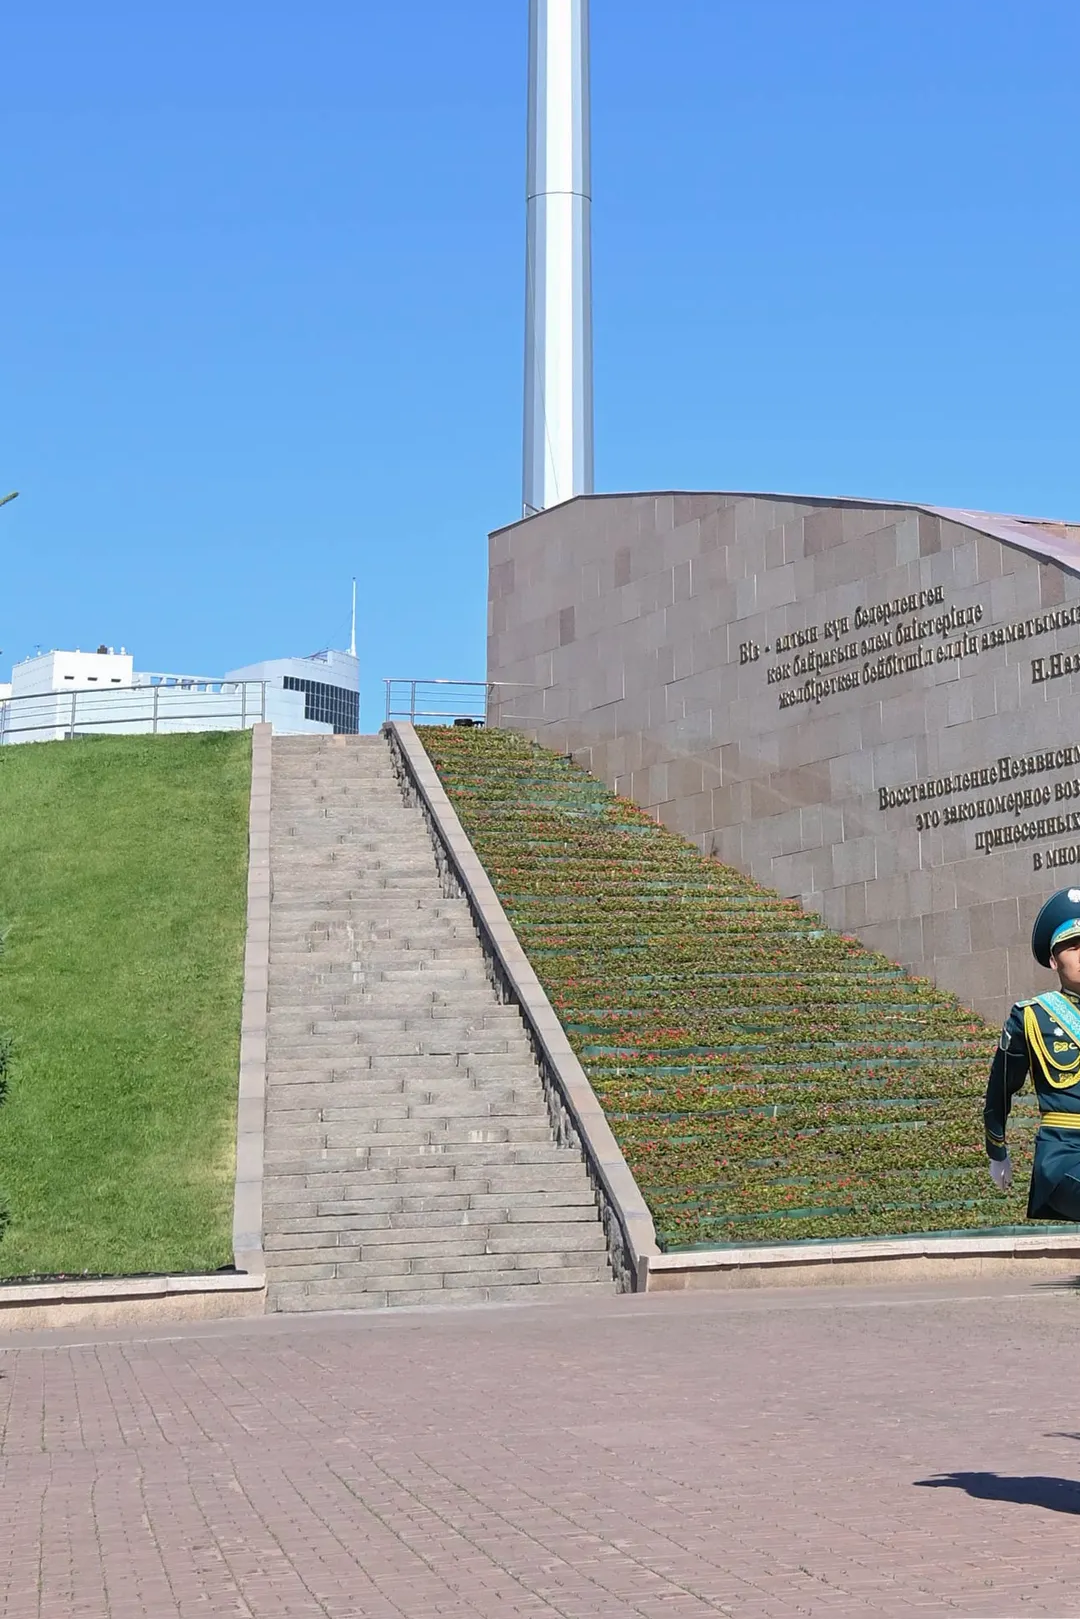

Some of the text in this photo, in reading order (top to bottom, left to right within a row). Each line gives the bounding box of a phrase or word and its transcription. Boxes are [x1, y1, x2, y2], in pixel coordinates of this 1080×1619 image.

[739, 640, 761, 665] Біз
[776, 625, 819, 654] алтын
[823, 616, 850, 641] күн
[793, 641, 859, 676] байрағын
[861, 629, 893, 657] әлем
[895, 603, 983, 646] биіктерінде
[778, 670, 861, 710] желбіреткен
[862, 644, 935, 685] бейбітшіл
[936, 631, 980, 663] елдің
[878, 767, 998, 811] Восстановление
[916, 810, 940, 832] это
[943, 785, 1051, 826] закономерное
[975, 811, 1080, 855] принесенных
[1033, 851, 1043, 871] в
